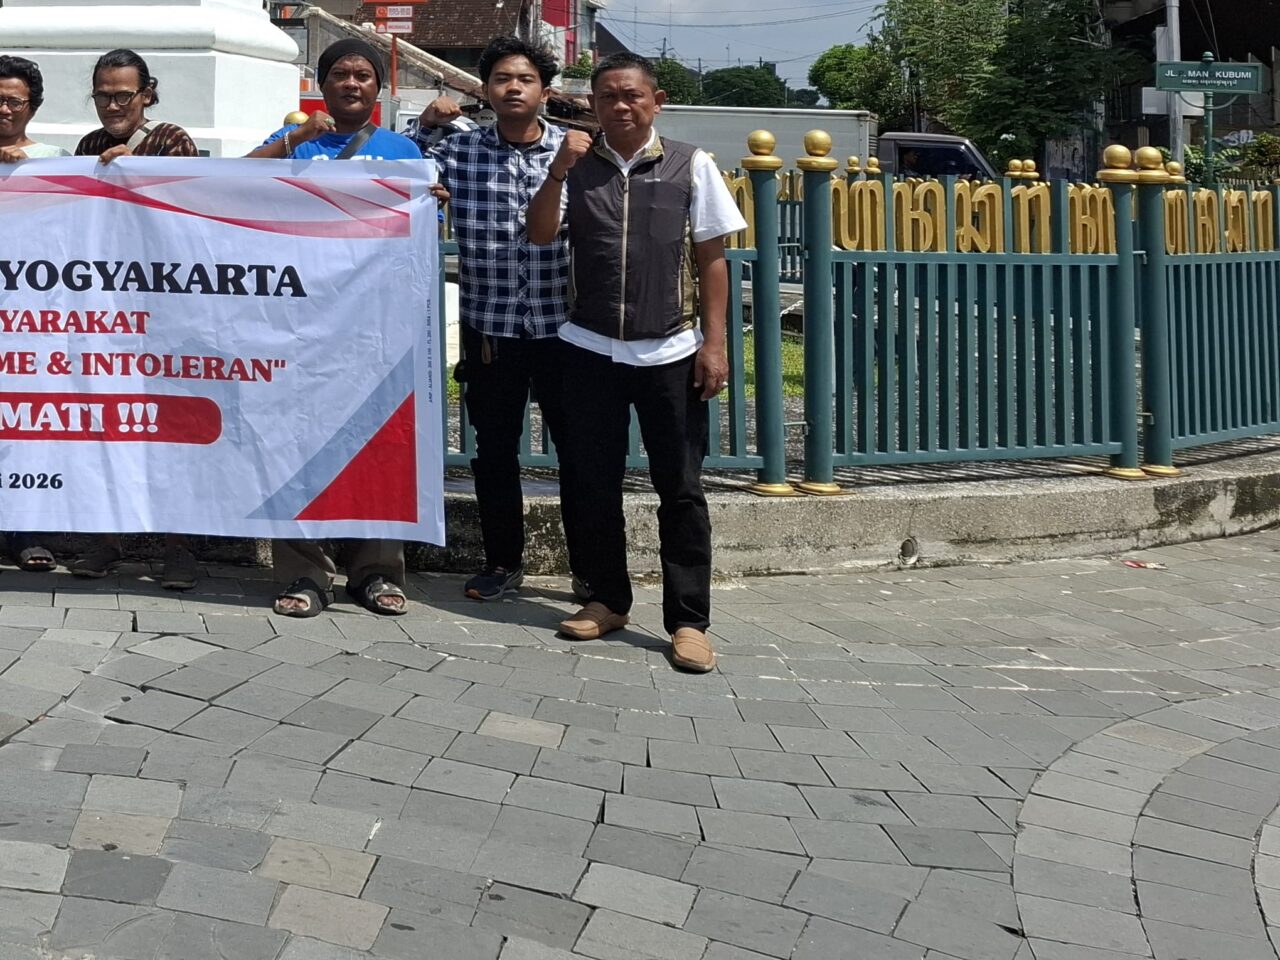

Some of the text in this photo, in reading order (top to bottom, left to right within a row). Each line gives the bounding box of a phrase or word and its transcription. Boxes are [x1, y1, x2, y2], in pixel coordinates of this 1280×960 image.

[46, 351, 72, 375] &
[81, 352, 286, 383] INTOLERAN"
[116, 402, 159, 434] !!!
[9, 473, 63, 489] 2026
